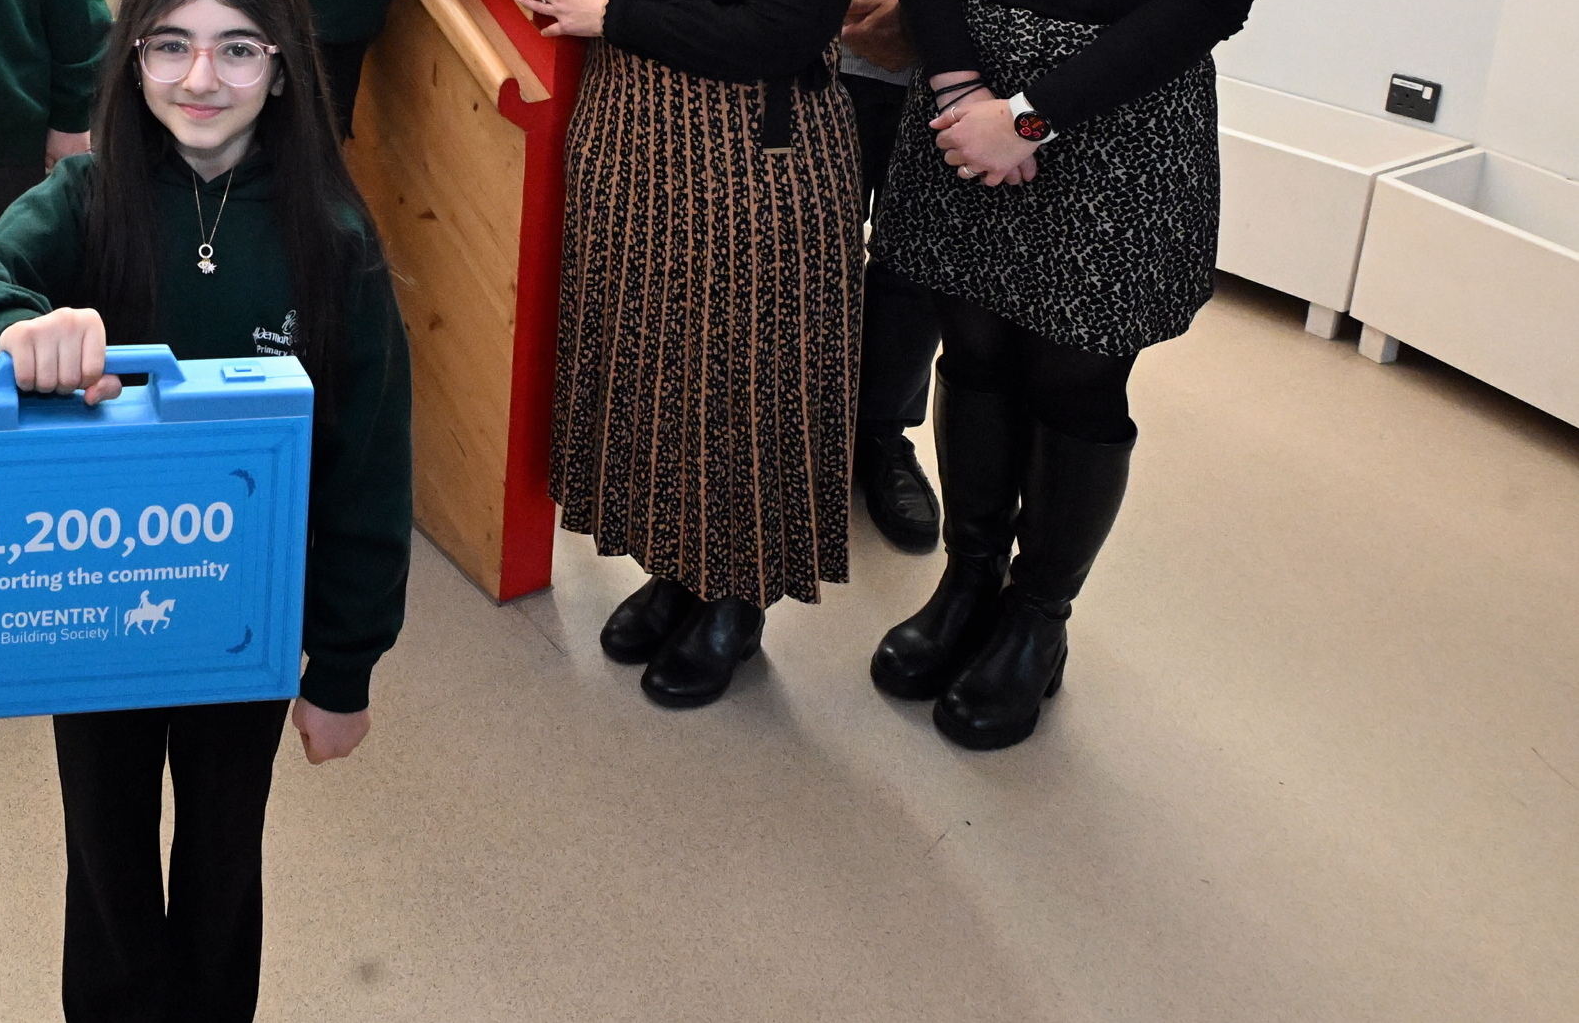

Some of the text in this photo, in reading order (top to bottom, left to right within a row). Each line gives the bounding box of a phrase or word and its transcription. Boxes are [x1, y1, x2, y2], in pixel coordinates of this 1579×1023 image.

[256, 344, 289, 357] Primary
[67, 566, 105, 587] the
[107, 559, 230, 584] community
[1, 606, 110, 630] COVENTRY
[1, 626, 110, 645] Building Society
